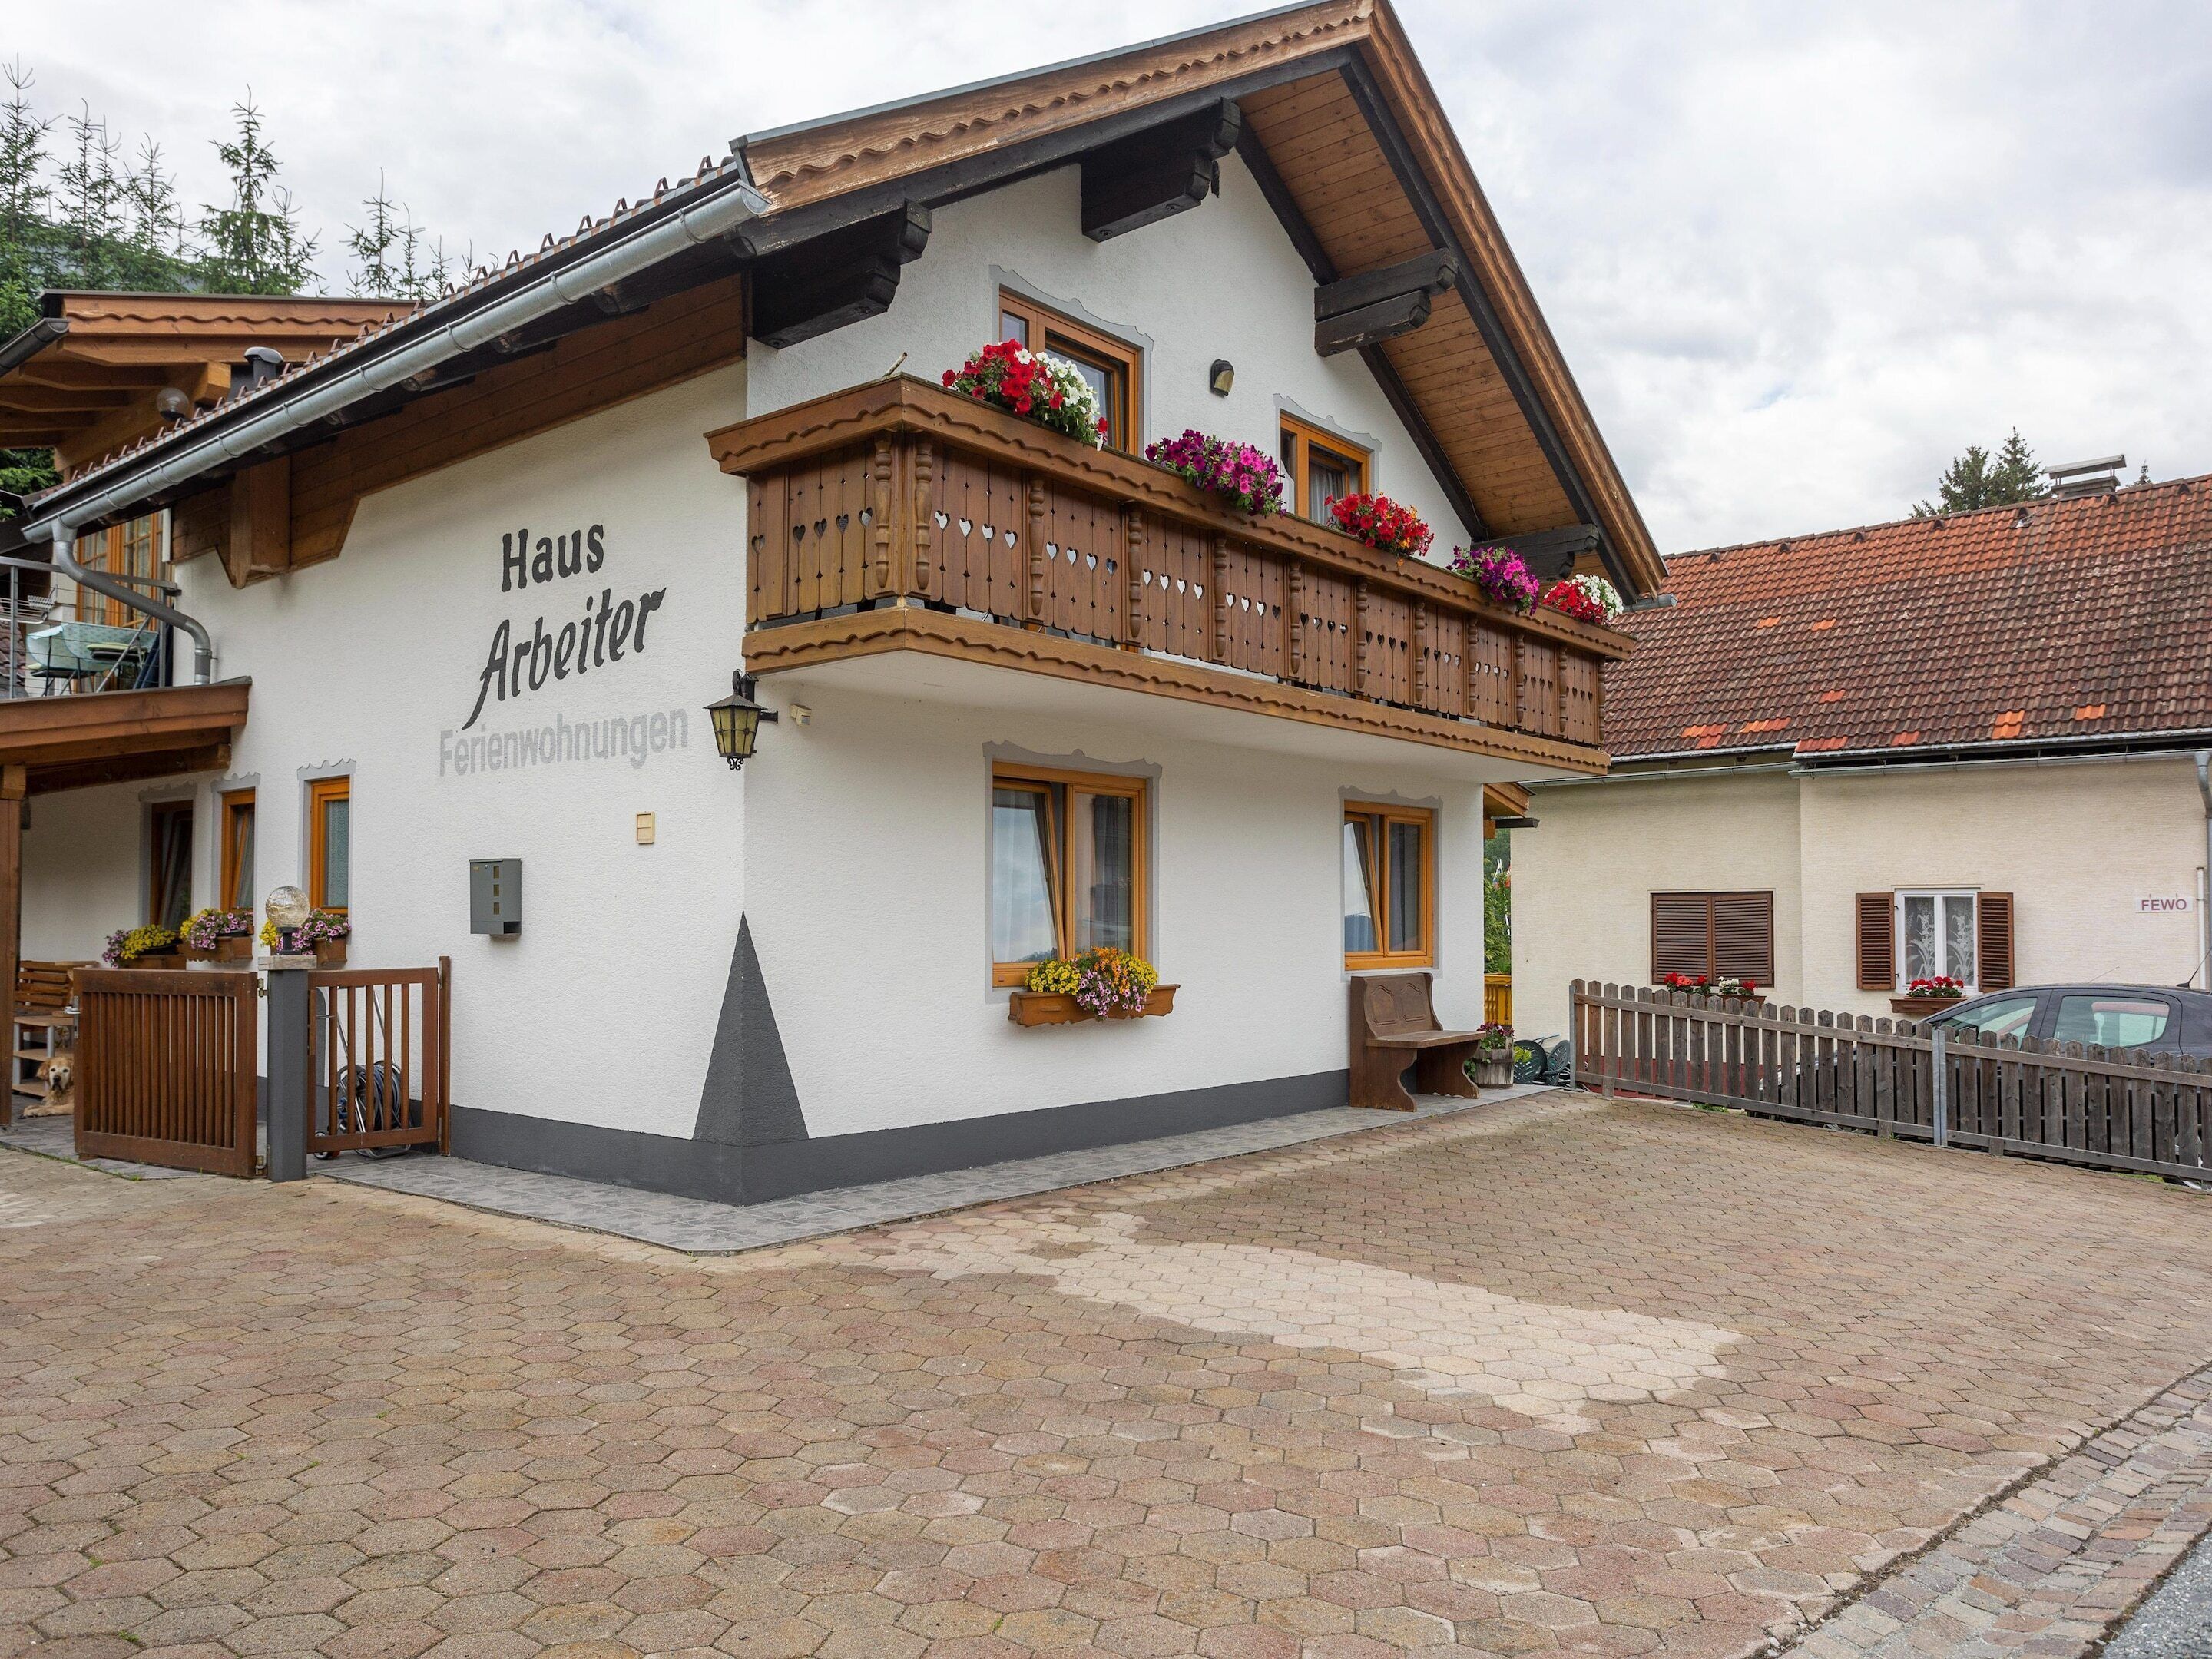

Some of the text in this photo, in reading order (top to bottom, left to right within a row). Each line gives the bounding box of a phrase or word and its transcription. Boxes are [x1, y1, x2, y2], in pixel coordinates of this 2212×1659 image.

[502, 524, 604, 592] Haus
[462, 587, 667, 730] Arbeiter
[439, 708, 689, 777] Ferienwohnungen
[2141, 899, 2187, 911] FEWO
